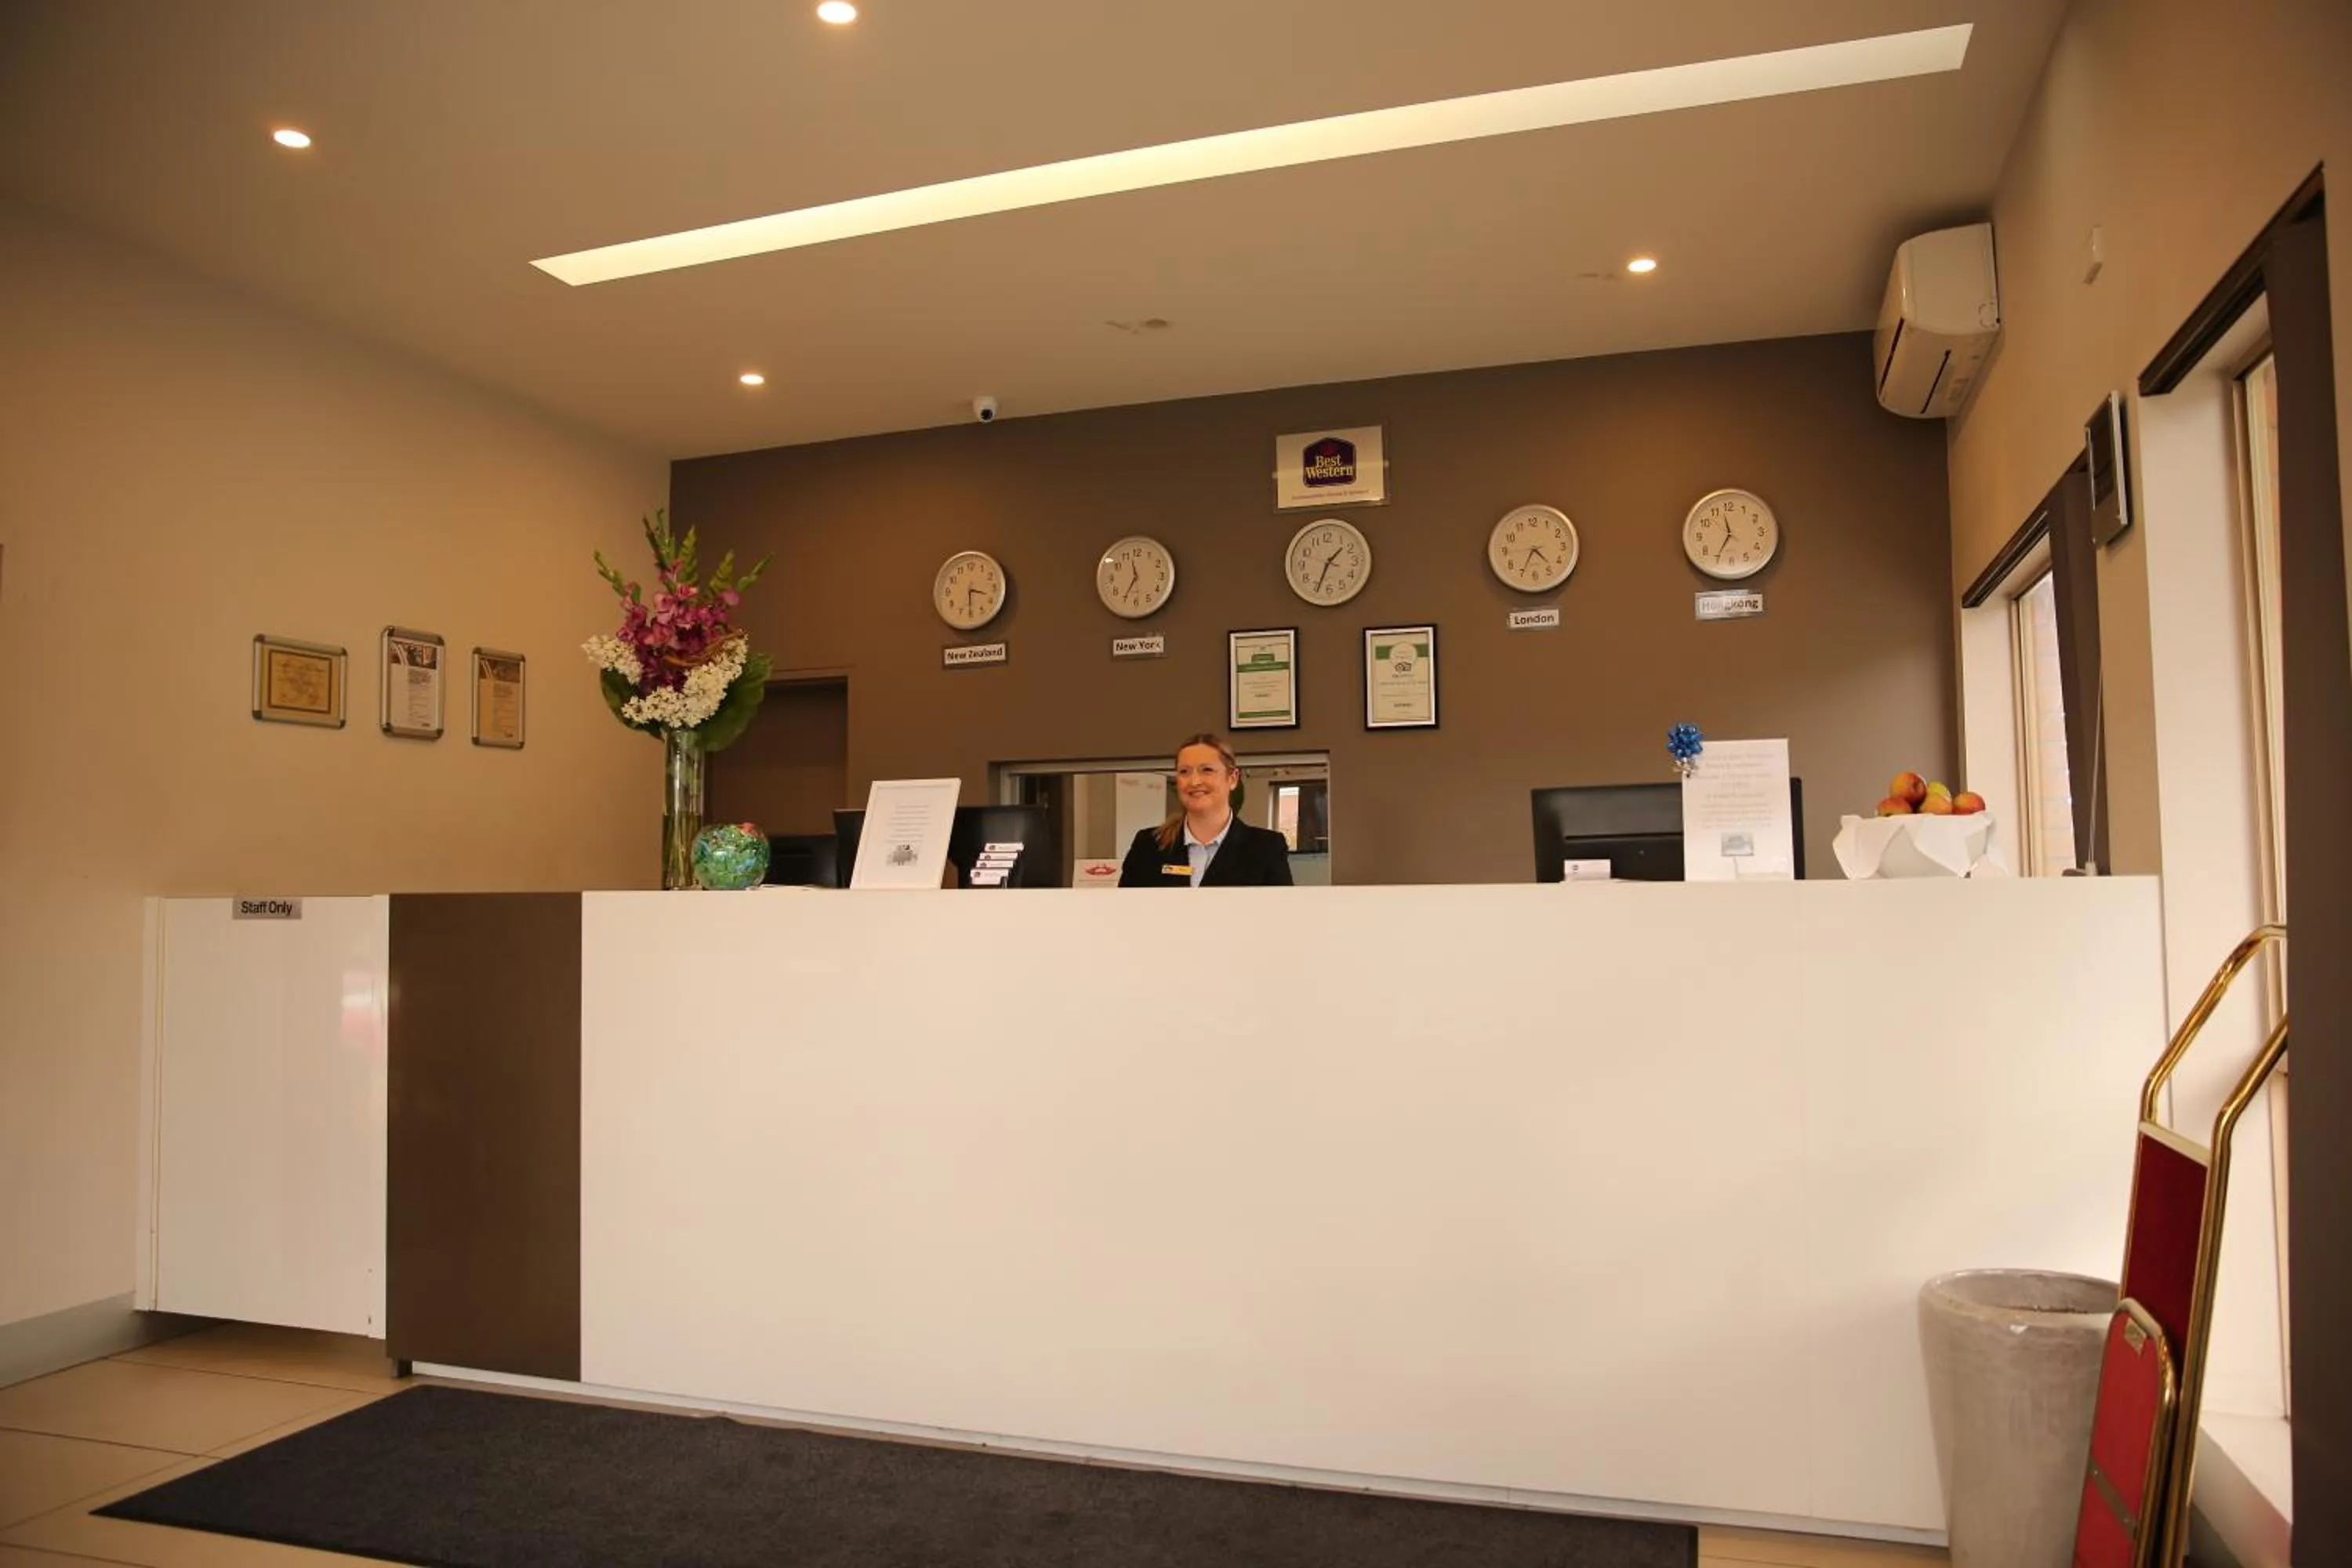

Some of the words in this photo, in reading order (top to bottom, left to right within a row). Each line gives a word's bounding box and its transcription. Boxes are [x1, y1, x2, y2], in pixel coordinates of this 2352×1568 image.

[1316, 455, 1342, 468] Best
[1305, 465, 1354, 479] Western
[1724, 501, 1733, 512] 12
[1740, 506, 1746, 515] 1
[1711, 507, 1719, 517] 11
[1528, 517, 1537, 528] 12
[1700, 517, 1710, 528] 10
[1752, 514, 1759, 524] 2
[1515, 521, 1523, 532] 11
[1544, 520, 1549, 529] 1
[1555, 528, 1561, 539] 2
[1757, 526, 1765, 537] 3
[1312, 536, 1319, 547] 11
[1323, 532, 1333, 543] 12
[1339, 535, 1343, 545] 1
[1506, 533, 1515, 543] 10
[1696, 532, 1703, 542] 9
[1347, 543, 1354, 554] 2
[1501, 546, 1508, 556] 9
[1560, 542, 1566, 551] 3
[1702, 545, 1708, 556] 8
[1754, 542, 1761, 551] 4
[1122, 552, 1130, 561] 11
[1133, 548, 1142, 557] 12
[1302, 547, 1312, 557] 10
[1743, 552, 1750, 562] 5
[1155, 558, 1161, 568] 2
[1351, 554, 1359, 567] 3
[1556, 555, 1563, 564] 4
[1714, 554, 1721, 564] 7
[1729, 556, 1735, 566] 6
[967, 562, 975, 571] 12
[1114, 562, 1122, 572] 10
[1298, 559, 1305, 572] 9
[1508, 560, 1514, 570] 8
[957, 566, 964, 575] 11
[1348, 569, 1354, 580] 4
[1519, 568, 1525, 578] 7
[1532, 570, 1539, 581] 6
[1545, 565, 1553, 576] 5
[949, 575, 957, 584] 10
[987, 572, 993, 580] 2
[1160, 571, 1165, 581] 3
[1302, 573, 1310, 583] 8
[1154, 583, 1160, 593] 4
[1326, 584, 1334, 594] 6
[1338, 579, 1346, 590] 5
[946, 586, 951, 597] 9
[1112, 586, 1119, 596] 8
[1123, 594, 1128, 603] 7
[1133, 598, 1139, 608] 6
[1145, 593, 1152, 603] 5
[1514, 614, 1555, 625] London
[1116, 641, 1137, 652] New
[1138, 640, 1160, 651] York
[947, 650, 966, 659] New
[968, 646, 1003, 659] Zealand
[241, 900, 267, 914] Staff
[269, 900, 292, 916] Only
